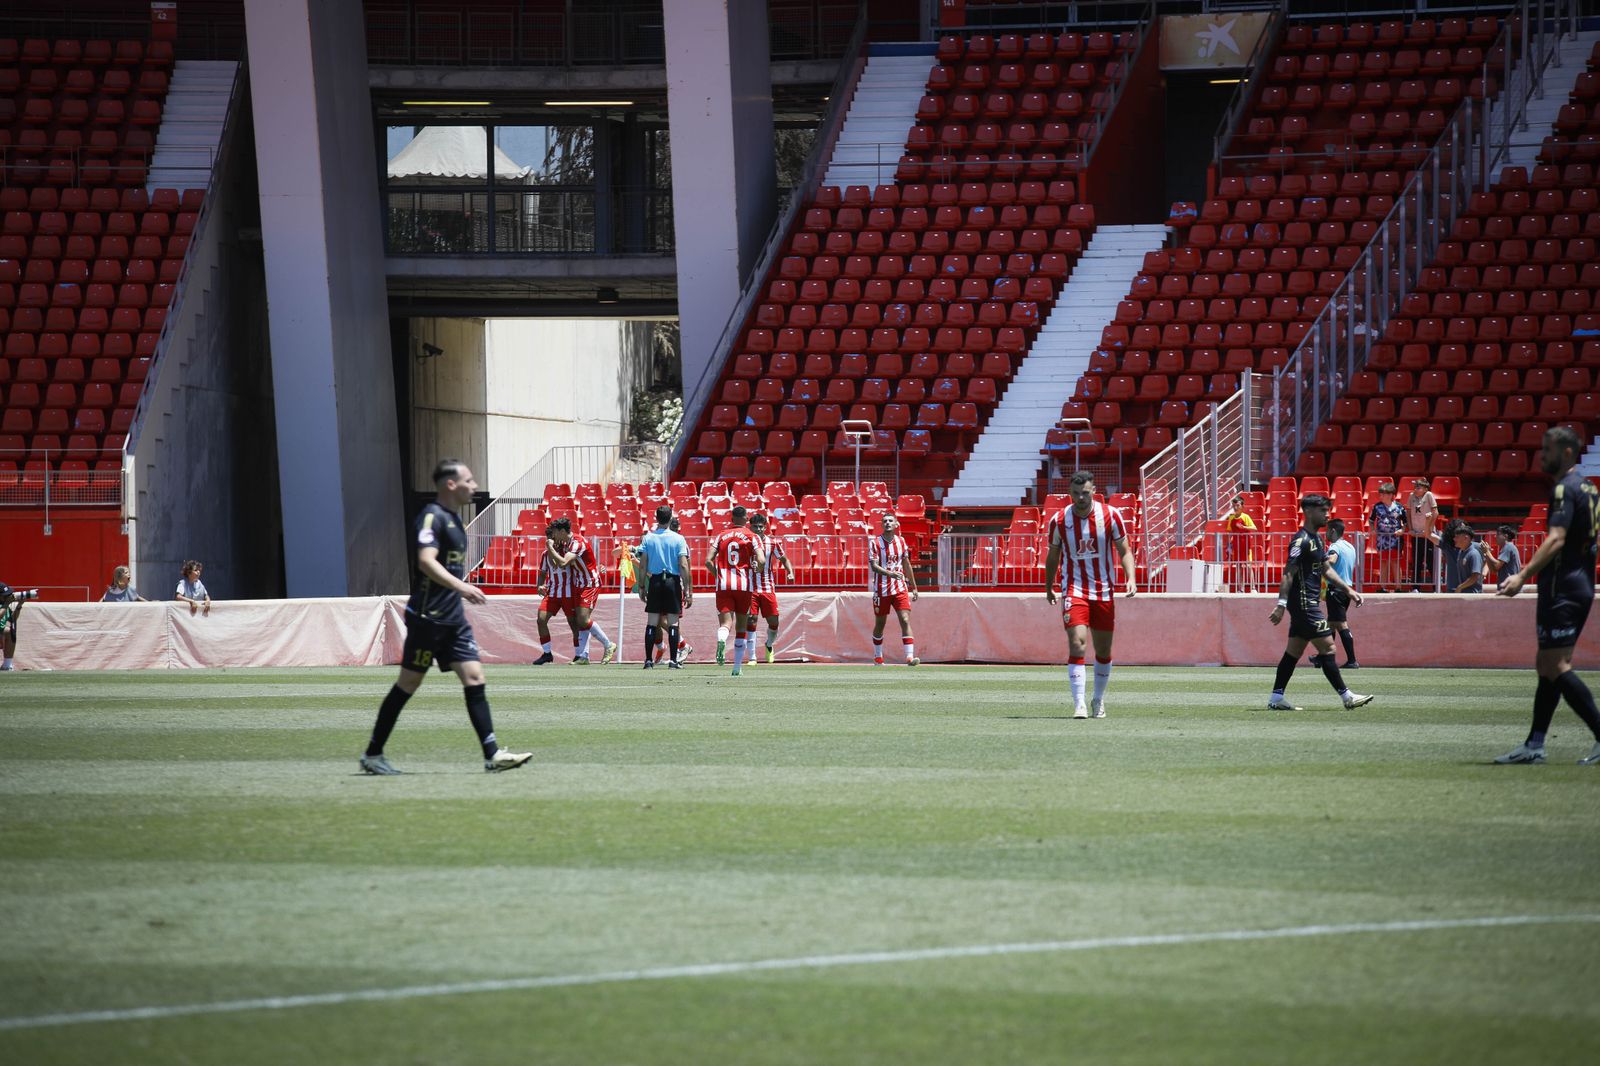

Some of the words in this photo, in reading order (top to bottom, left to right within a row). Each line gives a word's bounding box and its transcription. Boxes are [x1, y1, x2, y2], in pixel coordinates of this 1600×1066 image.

[727, 541, 740, 566] 6
[1314, 619, 1331, 632] 22
[413, 648, 433, 667] 18
